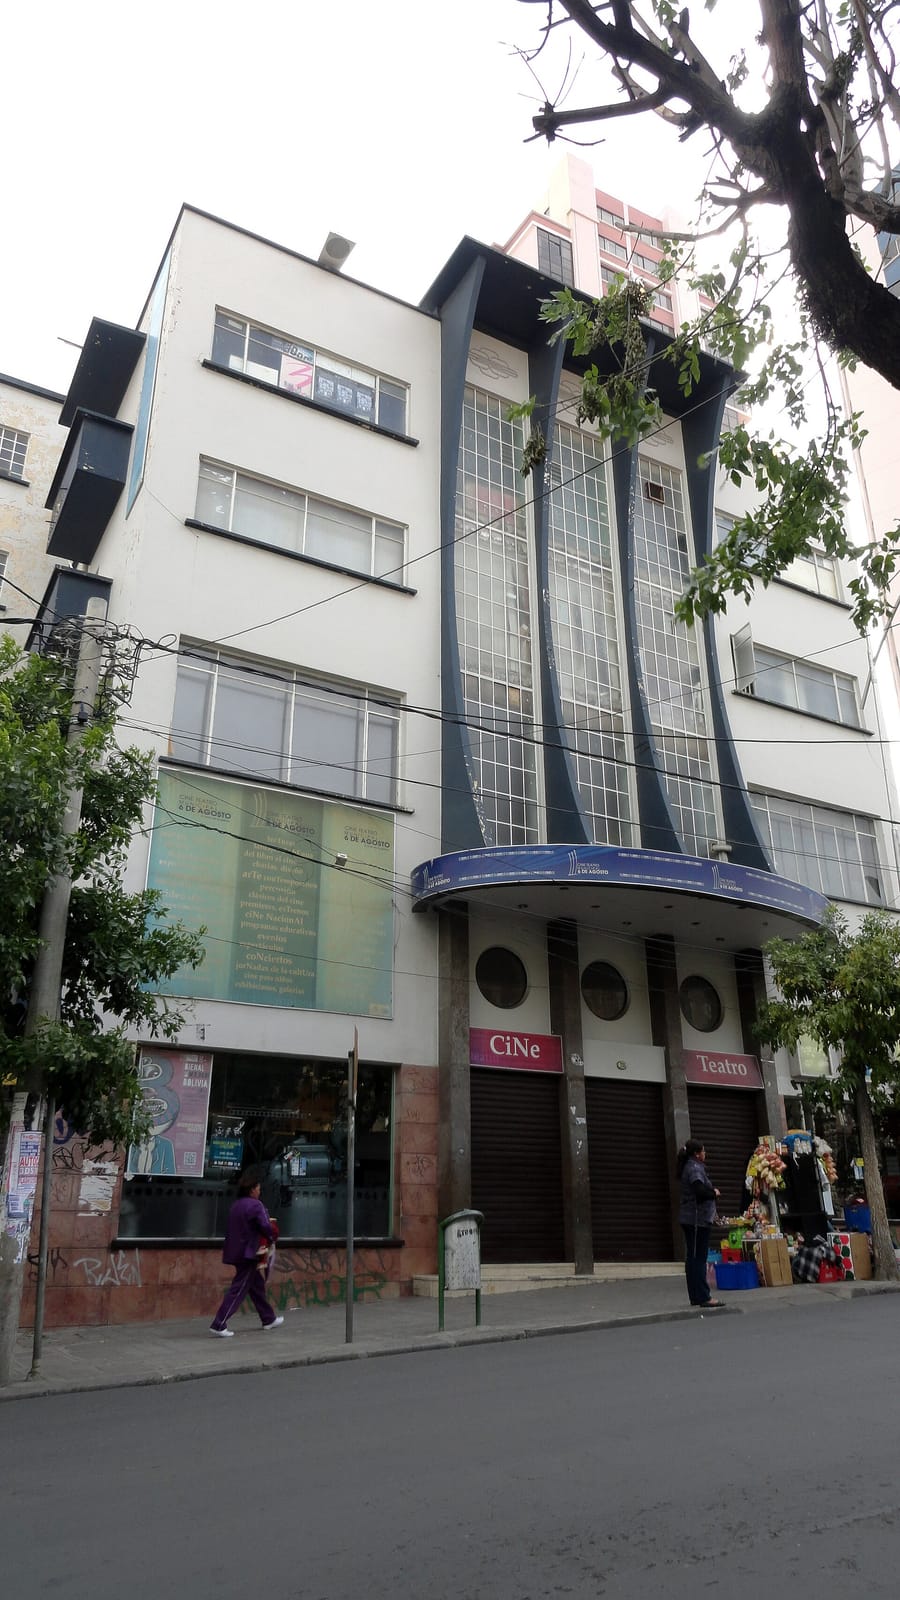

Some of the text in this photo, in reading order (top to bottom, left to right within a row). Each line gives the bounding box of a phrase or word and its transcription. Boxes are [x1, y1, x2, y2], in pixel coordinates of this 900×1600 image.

[178, 804, 232, 820] 6 DE AGOSTO
[284, 824, 316, 835] AGOSTO
[350, 835, 359, 843] DE
[360, 837, 391, 849] AGOSTO
[489, 1034, 541, 1060] CiNe
[696, 1054, 748, 1077] Teatro
[183, 1078, 208, 1090] BOLIVIA
